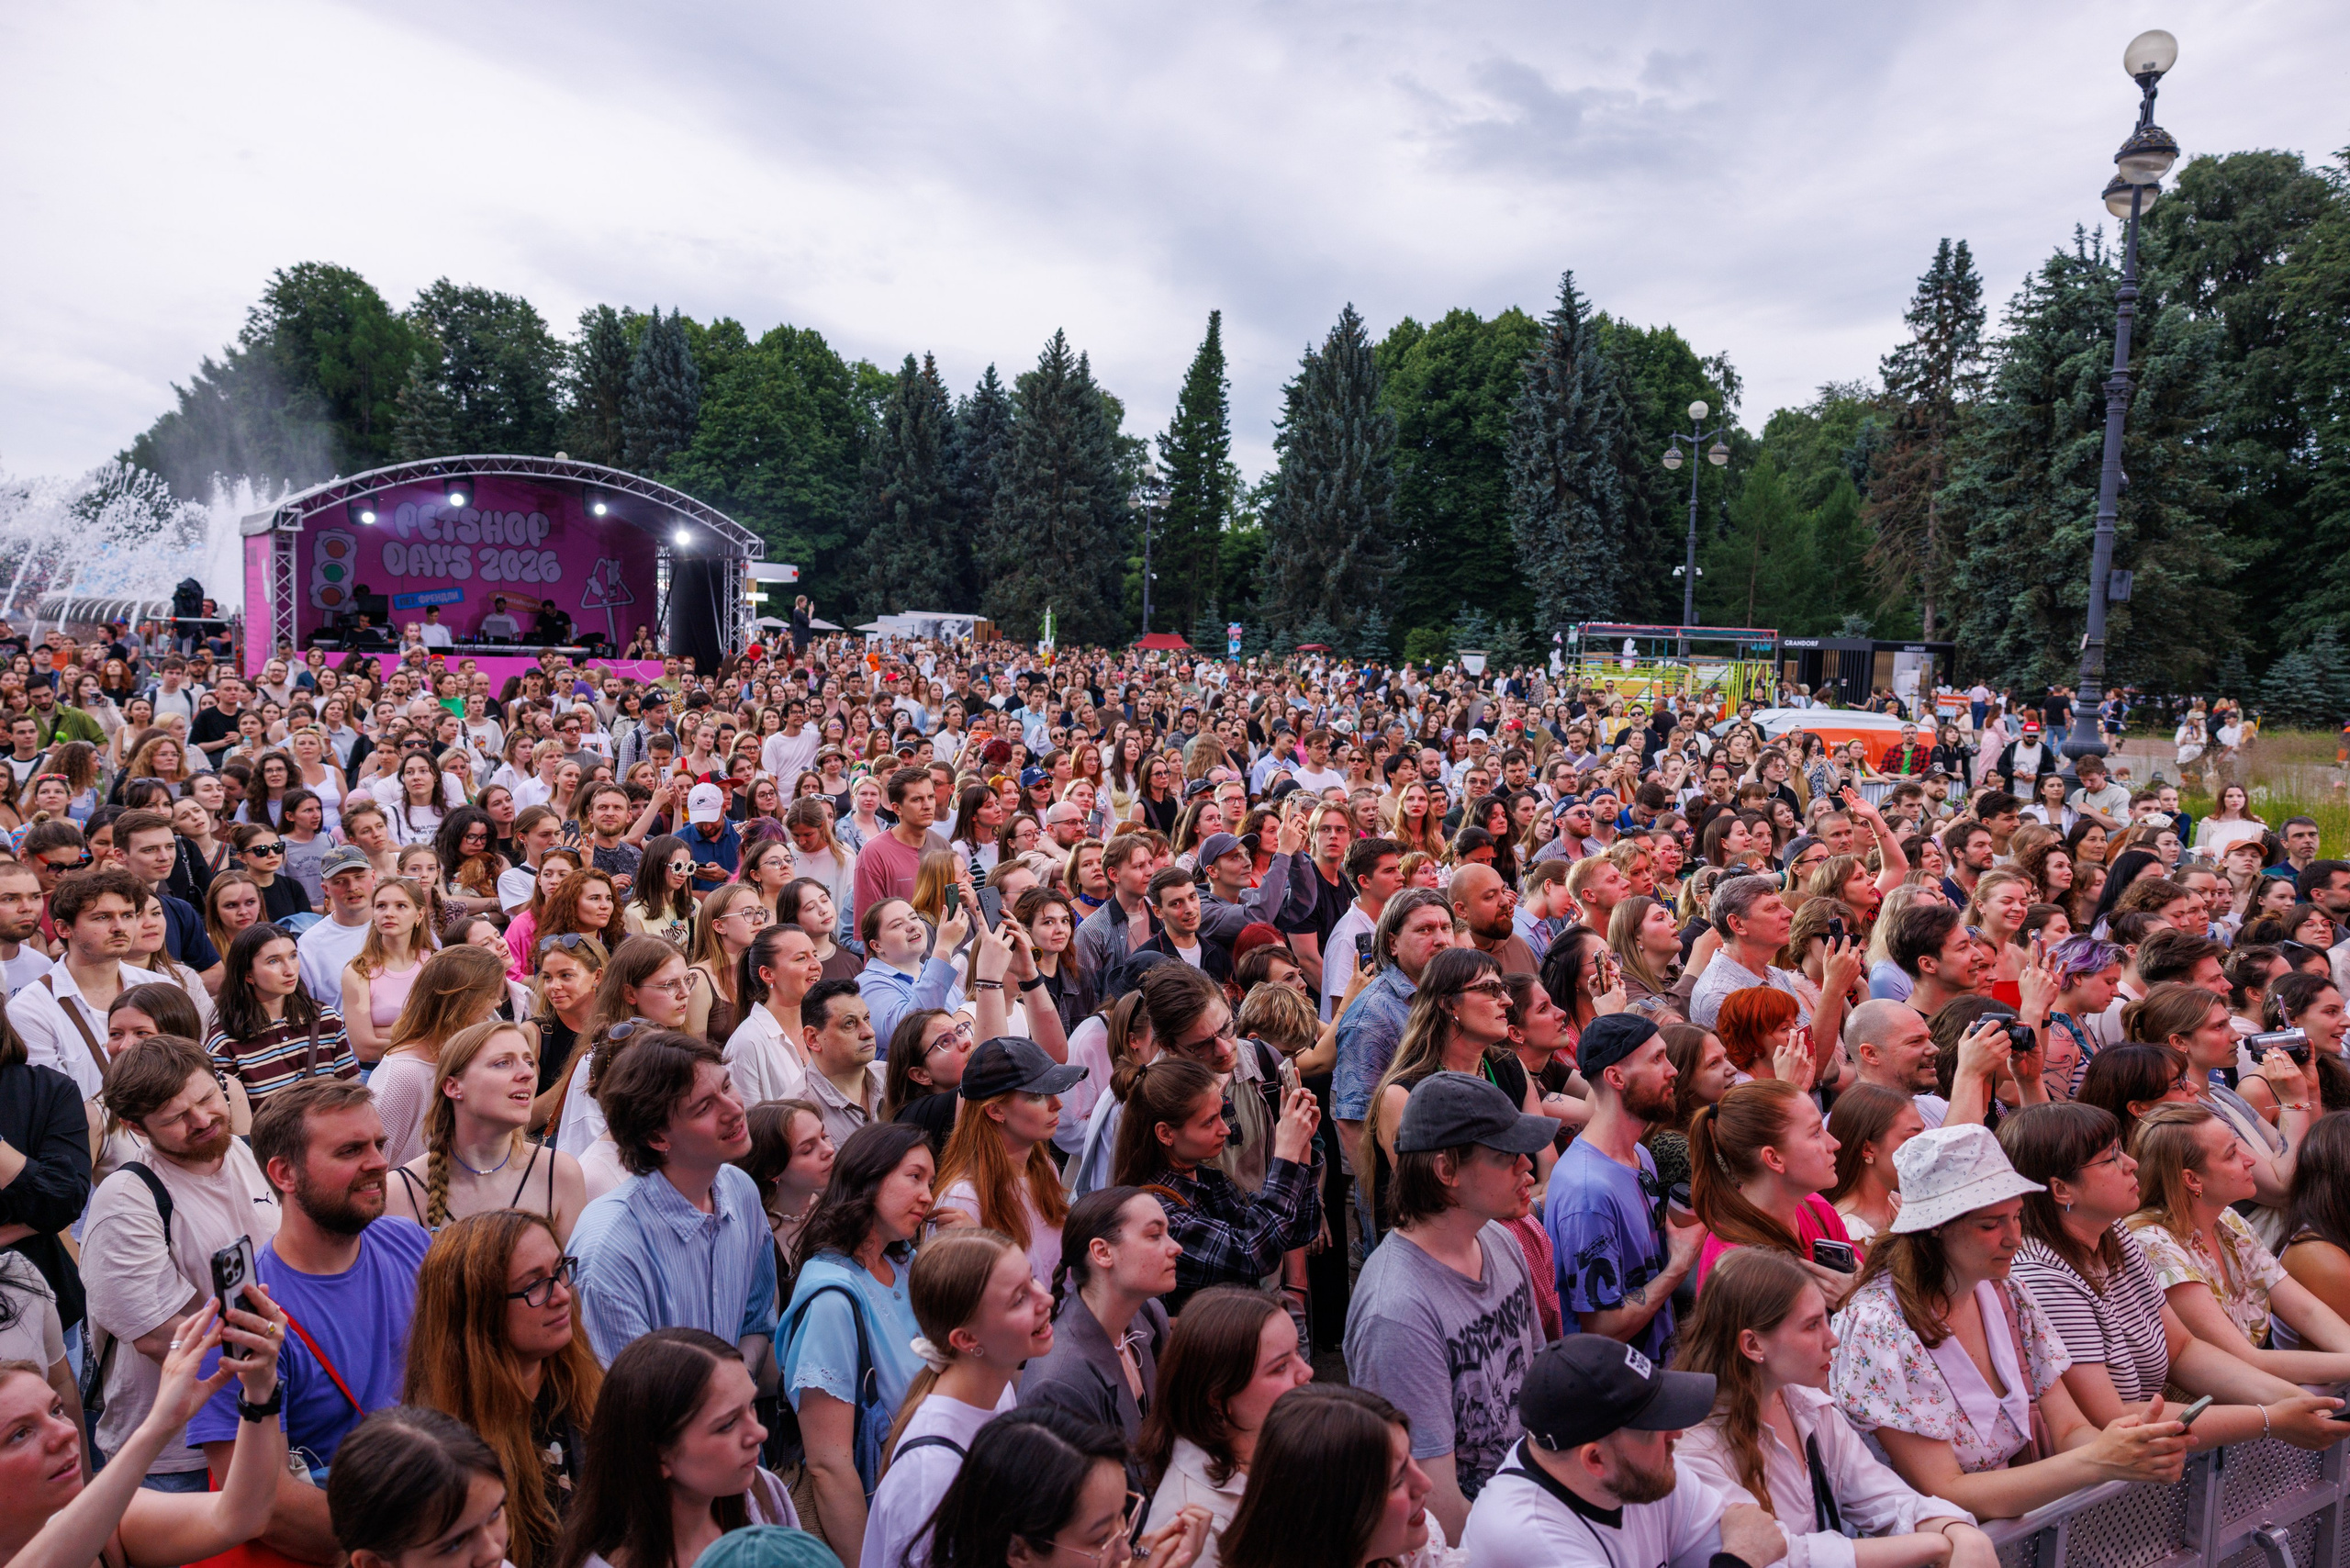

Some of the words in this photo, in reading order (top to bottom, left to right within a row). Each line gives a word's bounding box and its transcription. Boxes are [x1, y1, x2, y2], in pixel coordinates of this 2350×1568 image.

[395, 502, 550, 547] PETSHOP
[382, 541, 473, 580] DAYS
[477, 547, 562, 584] 2026
[1784, 639, 1819, 647] GRANDORF
